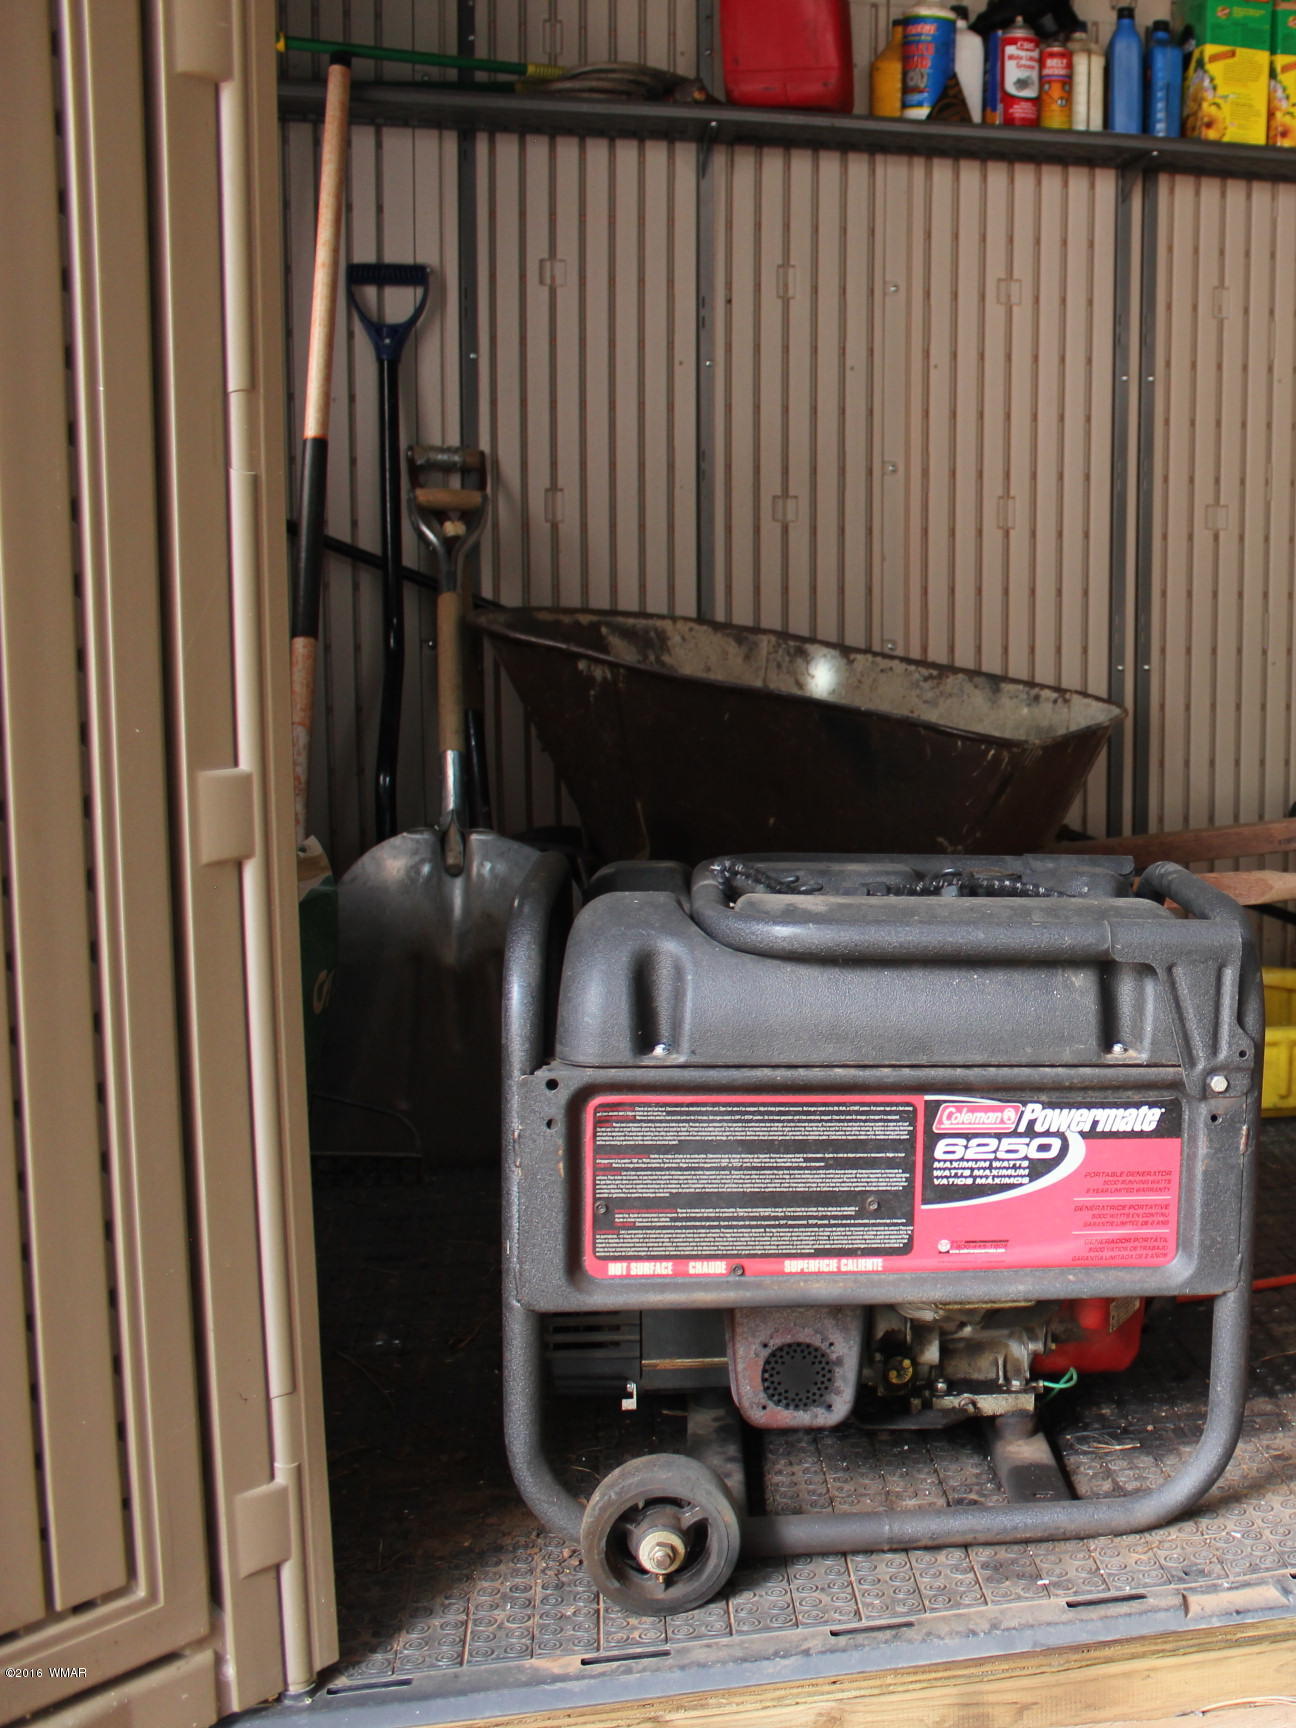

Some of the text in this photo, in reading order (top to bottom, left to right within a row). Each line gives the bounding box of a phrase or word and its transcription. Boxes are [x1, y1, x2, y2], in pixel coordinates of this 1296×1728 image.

[942, 1107, 1001, 1125] Coleman
[1017, 1103, 1162, 1132] Powermate
[933, 1137, 1062, 1159] 6250
[992, 1160, 1029, 1168] WATTS
[972, 1168, 1029, 1176] MAXIMUM
[607, 1261, 727, 1276] HOT SURFACE CHAUDE
[784, 1258, 883, 1273] SUPERFICIE CALIENTE
